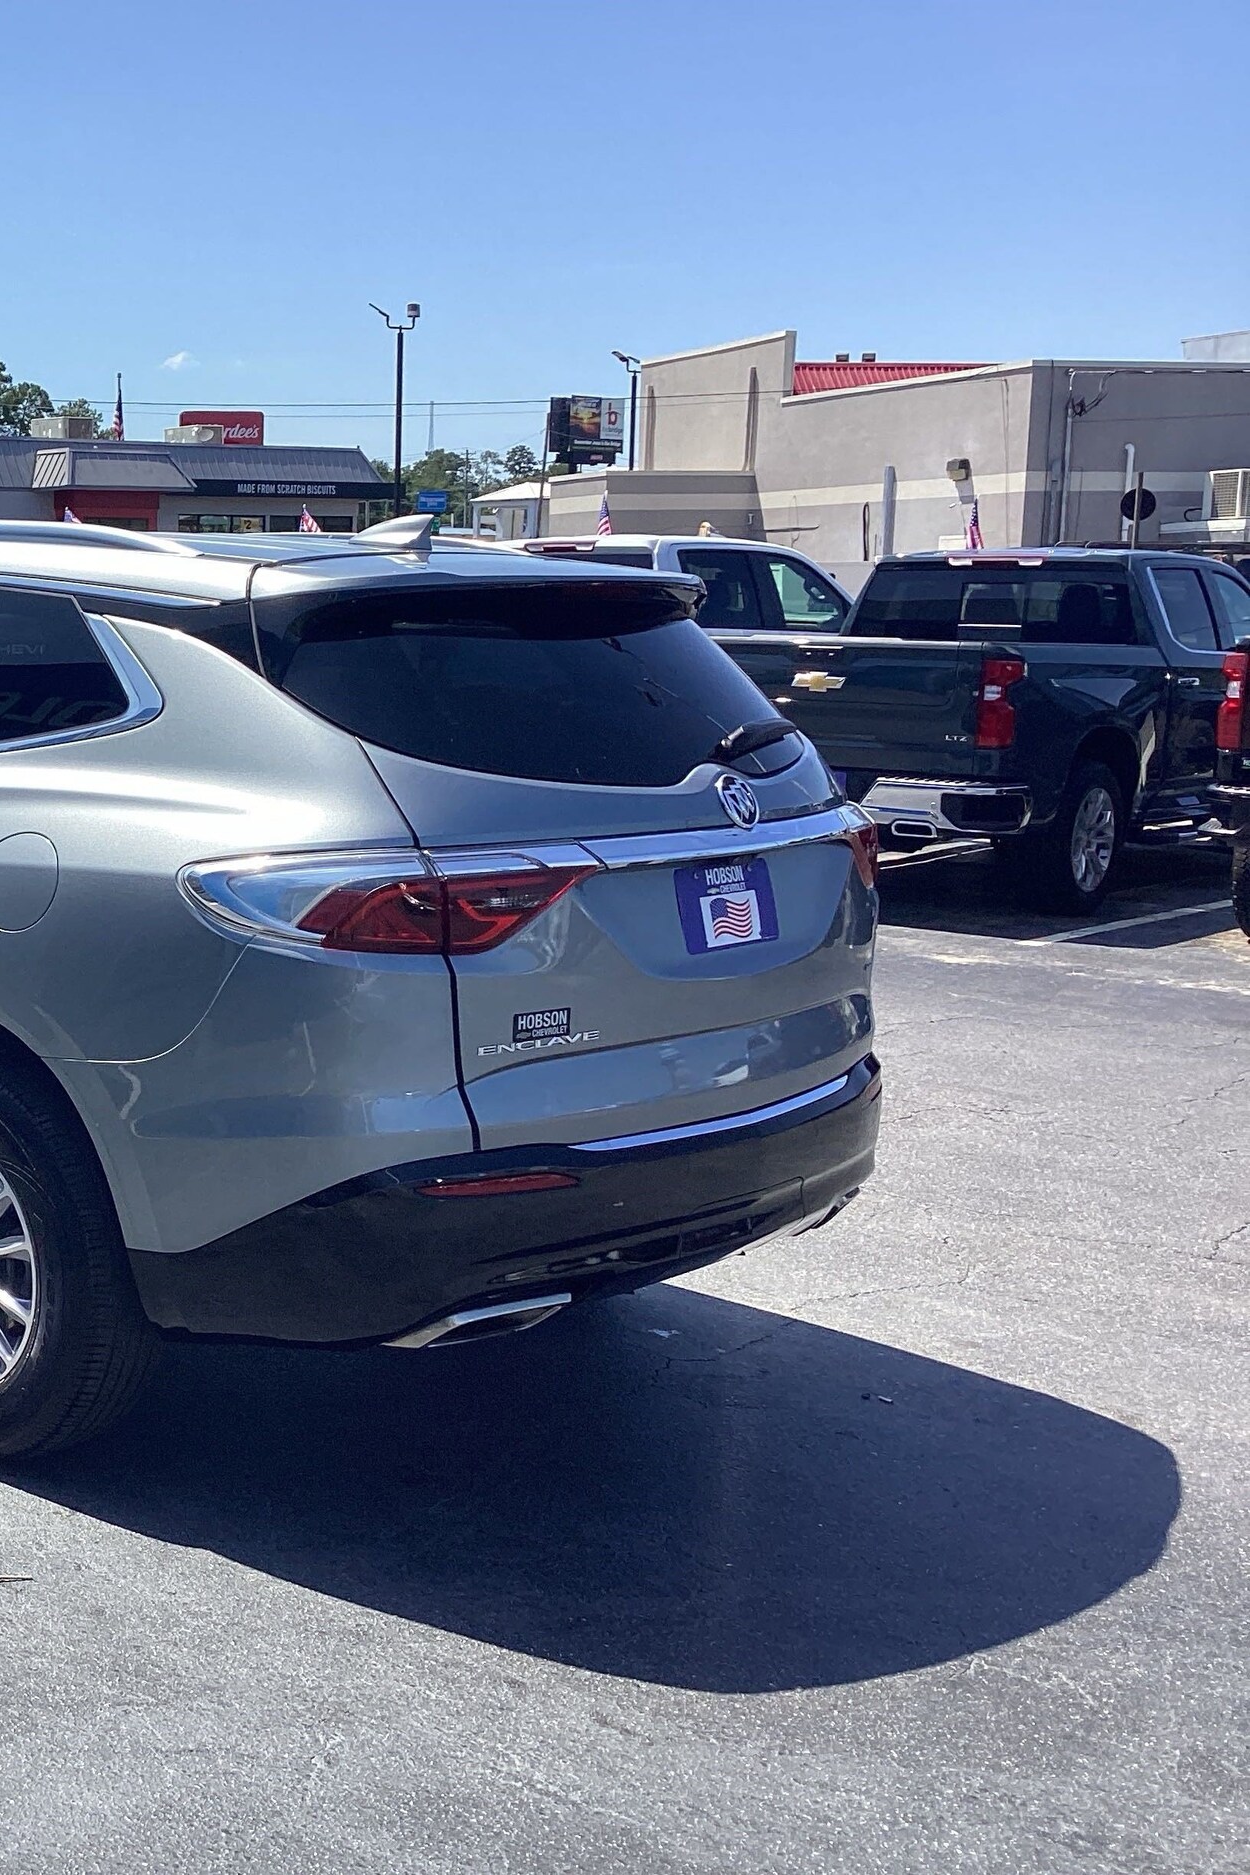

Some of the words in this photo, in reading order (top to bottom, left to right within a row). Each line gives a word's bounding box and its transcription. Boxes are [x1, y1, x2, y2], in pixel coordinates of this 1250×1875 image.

[223, 424, 260, 439] rdee's
[237, 483, 256, 494] MADE
[257, 484, 276, 494] FROM
[277, 484, 306, 495] SCRATCH
[307, 484, 336, 495] BISCUITS
[945, 734, 968, 742] LTZ
[704, 865, 745, 886] HOBSON
[719, 881, 747, 894] CHEVROLET
[517, 1009, 568, 1031] HOBSON
[531, 1024, 568, 1038] CHEVROLET
[477, 1030, 600, 1057] ENCLAVE
